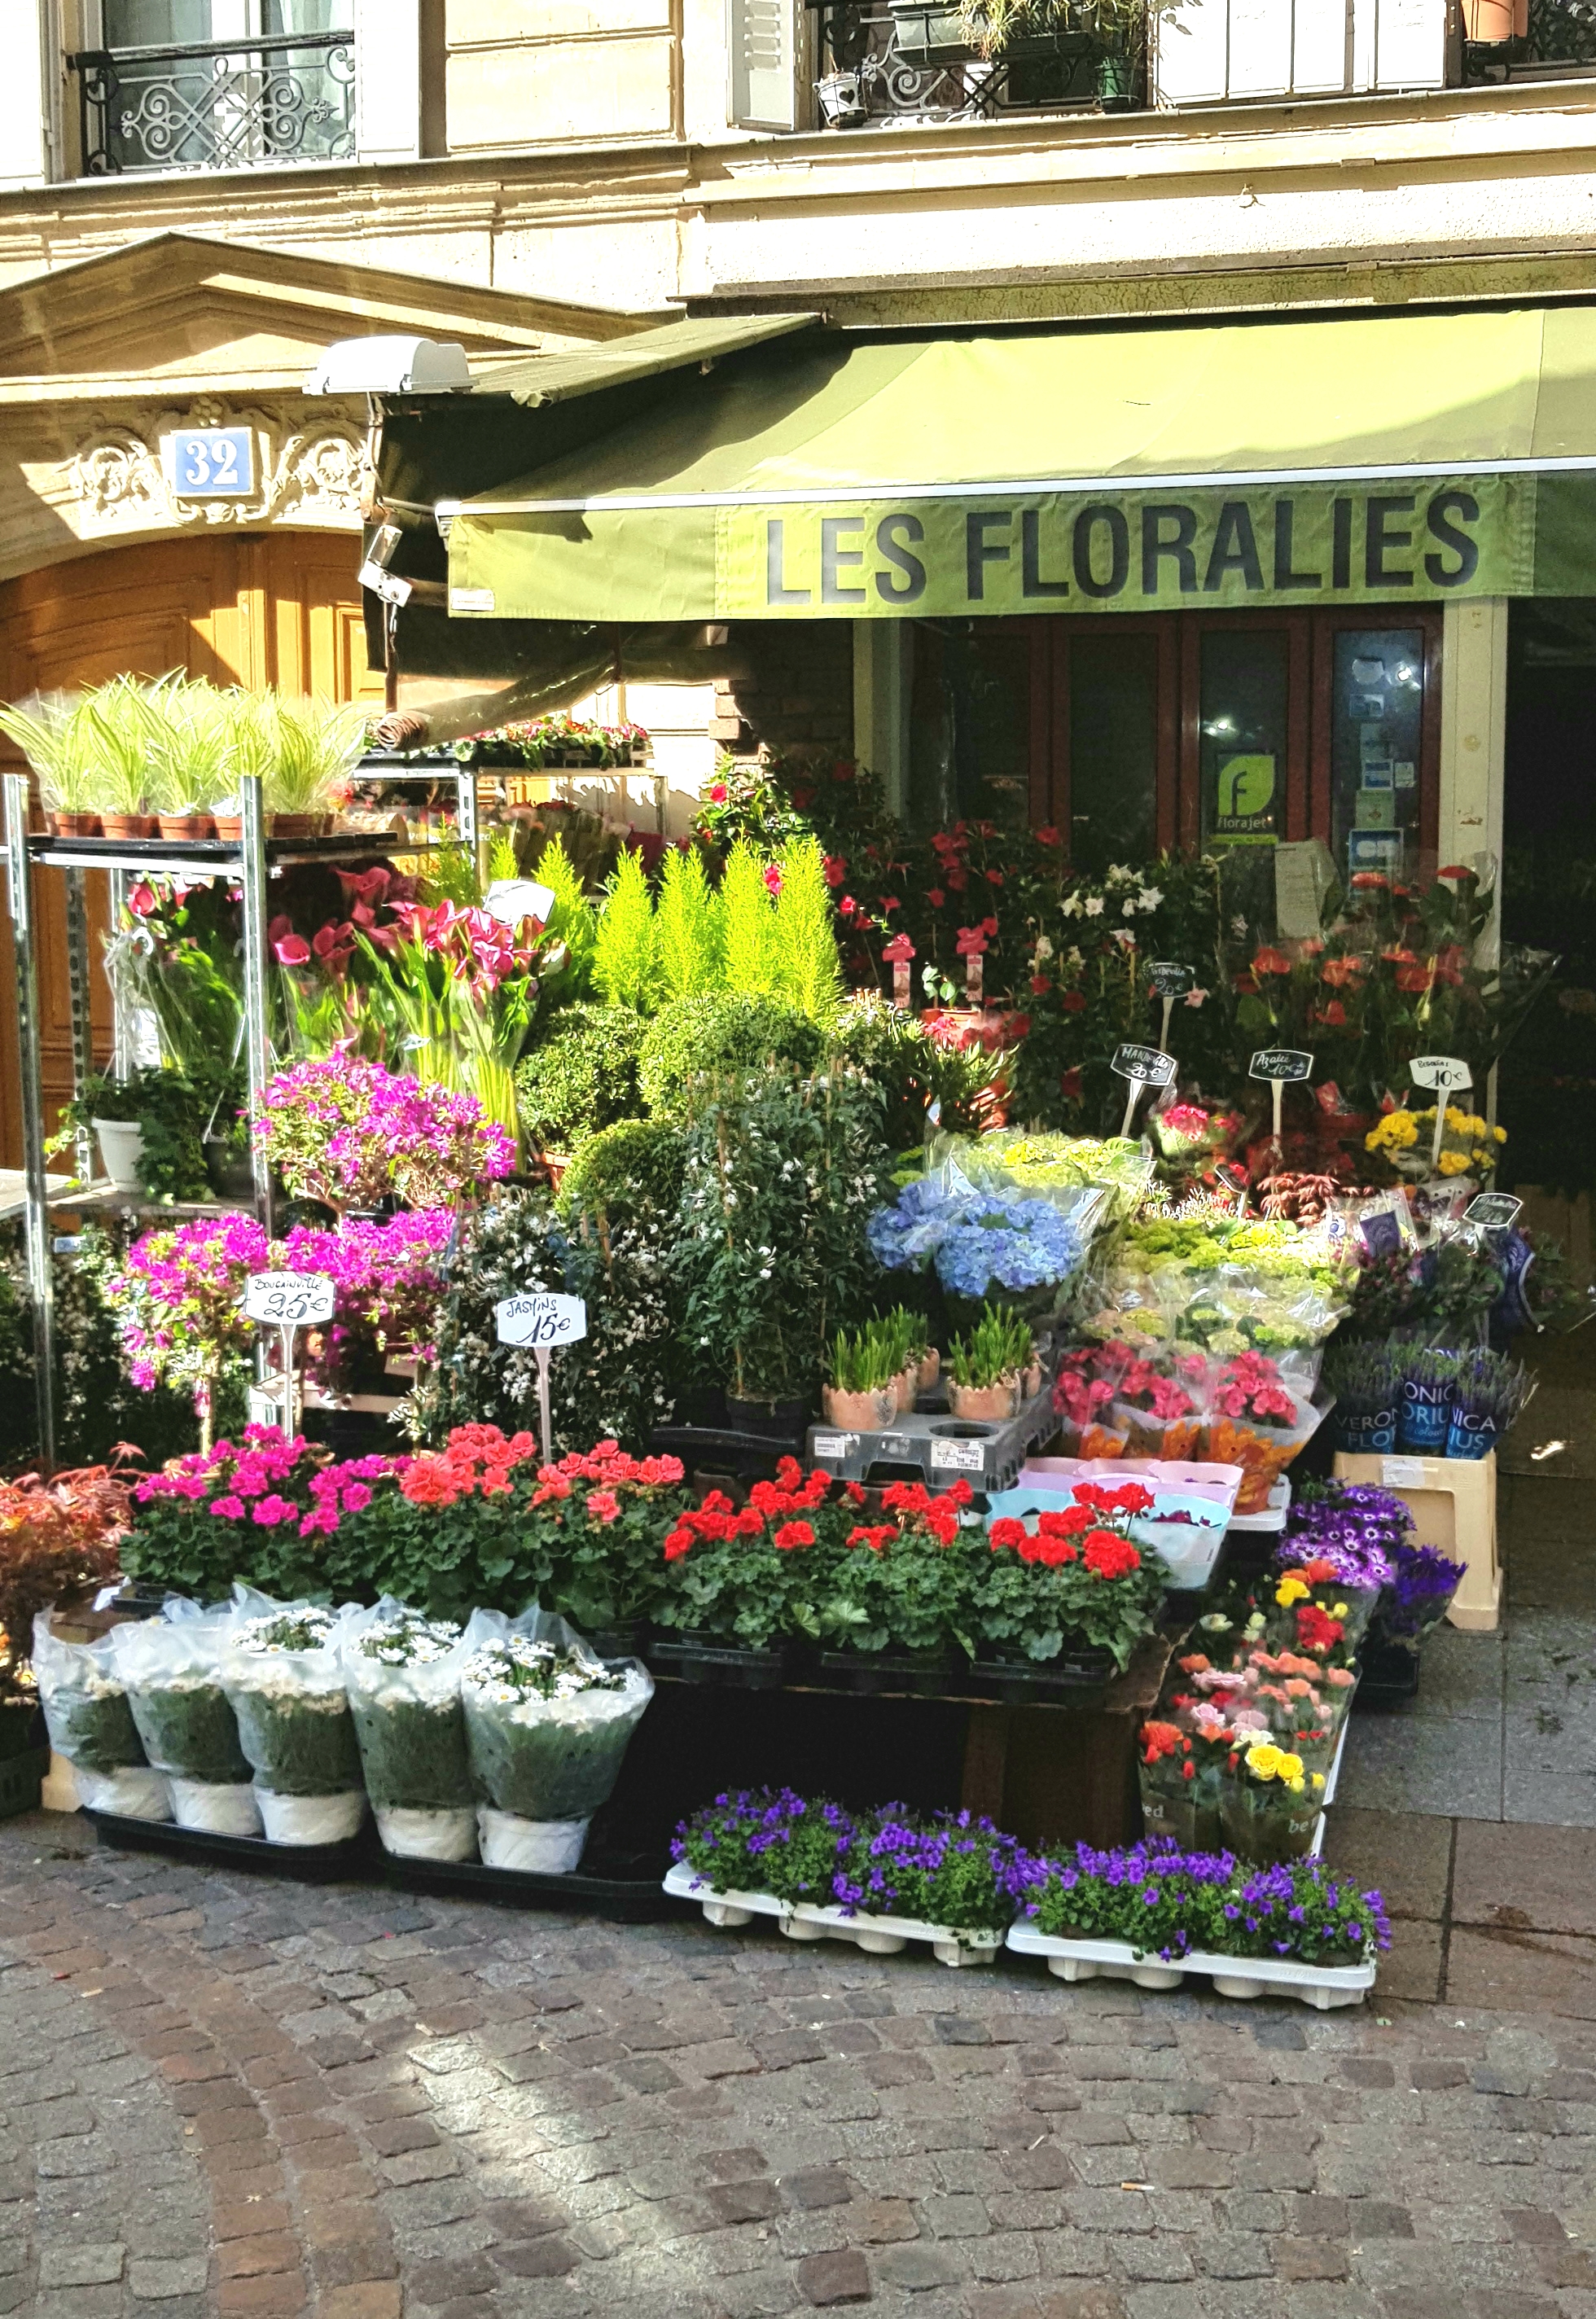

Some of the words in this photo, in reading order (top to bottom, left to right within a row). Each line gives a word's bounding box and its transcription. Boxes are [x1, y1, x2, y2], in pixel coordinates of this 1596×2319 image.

[186, 440, 239, 485] 32
[767, 513, 927, 605] LES
[967, 491, 1480, 601] FLORALIES
[1217, 817, 1267, 831] florajet
[264, 1293, 328, 1319] 25€
[515, 1313, 571, 1344] 15€
